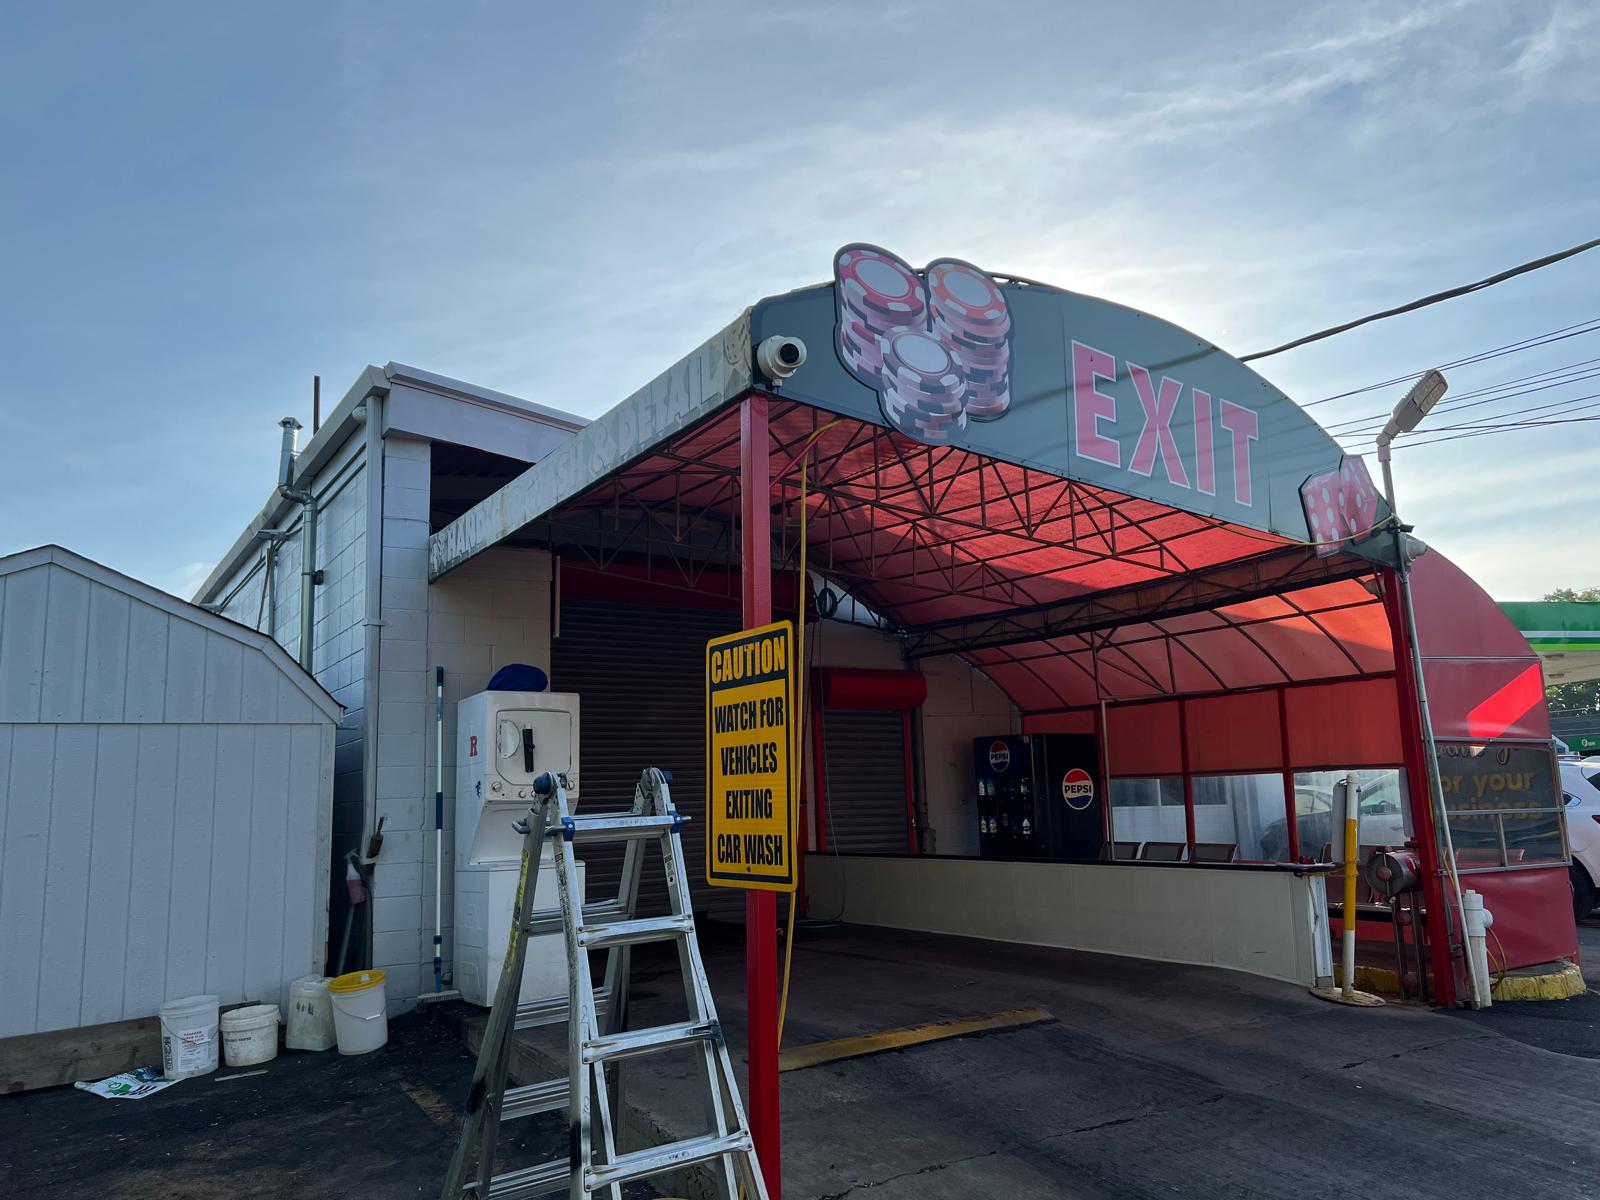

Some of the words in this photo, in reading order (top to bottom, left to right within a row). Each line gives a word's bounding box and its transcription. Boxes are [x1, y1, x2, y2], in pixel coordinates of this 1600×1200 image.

[617, 345, 723, 458] DETAIL
[1072, 339, 1259, 508] EXIT
[711, 635, 786, 685] CAUTION
[715, 700, 757, 734] WATCH
[760, 696, 784, 728] FOR
[720, 741, 777, 777] VEHICLES
[990, 753, 1009, 761] PEPSI
[1064, 784, 1092, 794] PEPSI
[1472, 771, 1536, 798] your
[725, 788, 773, 819] EXITING
[717, 834, 742, 865] CAR
[743, 834, 784, 866] WASH
